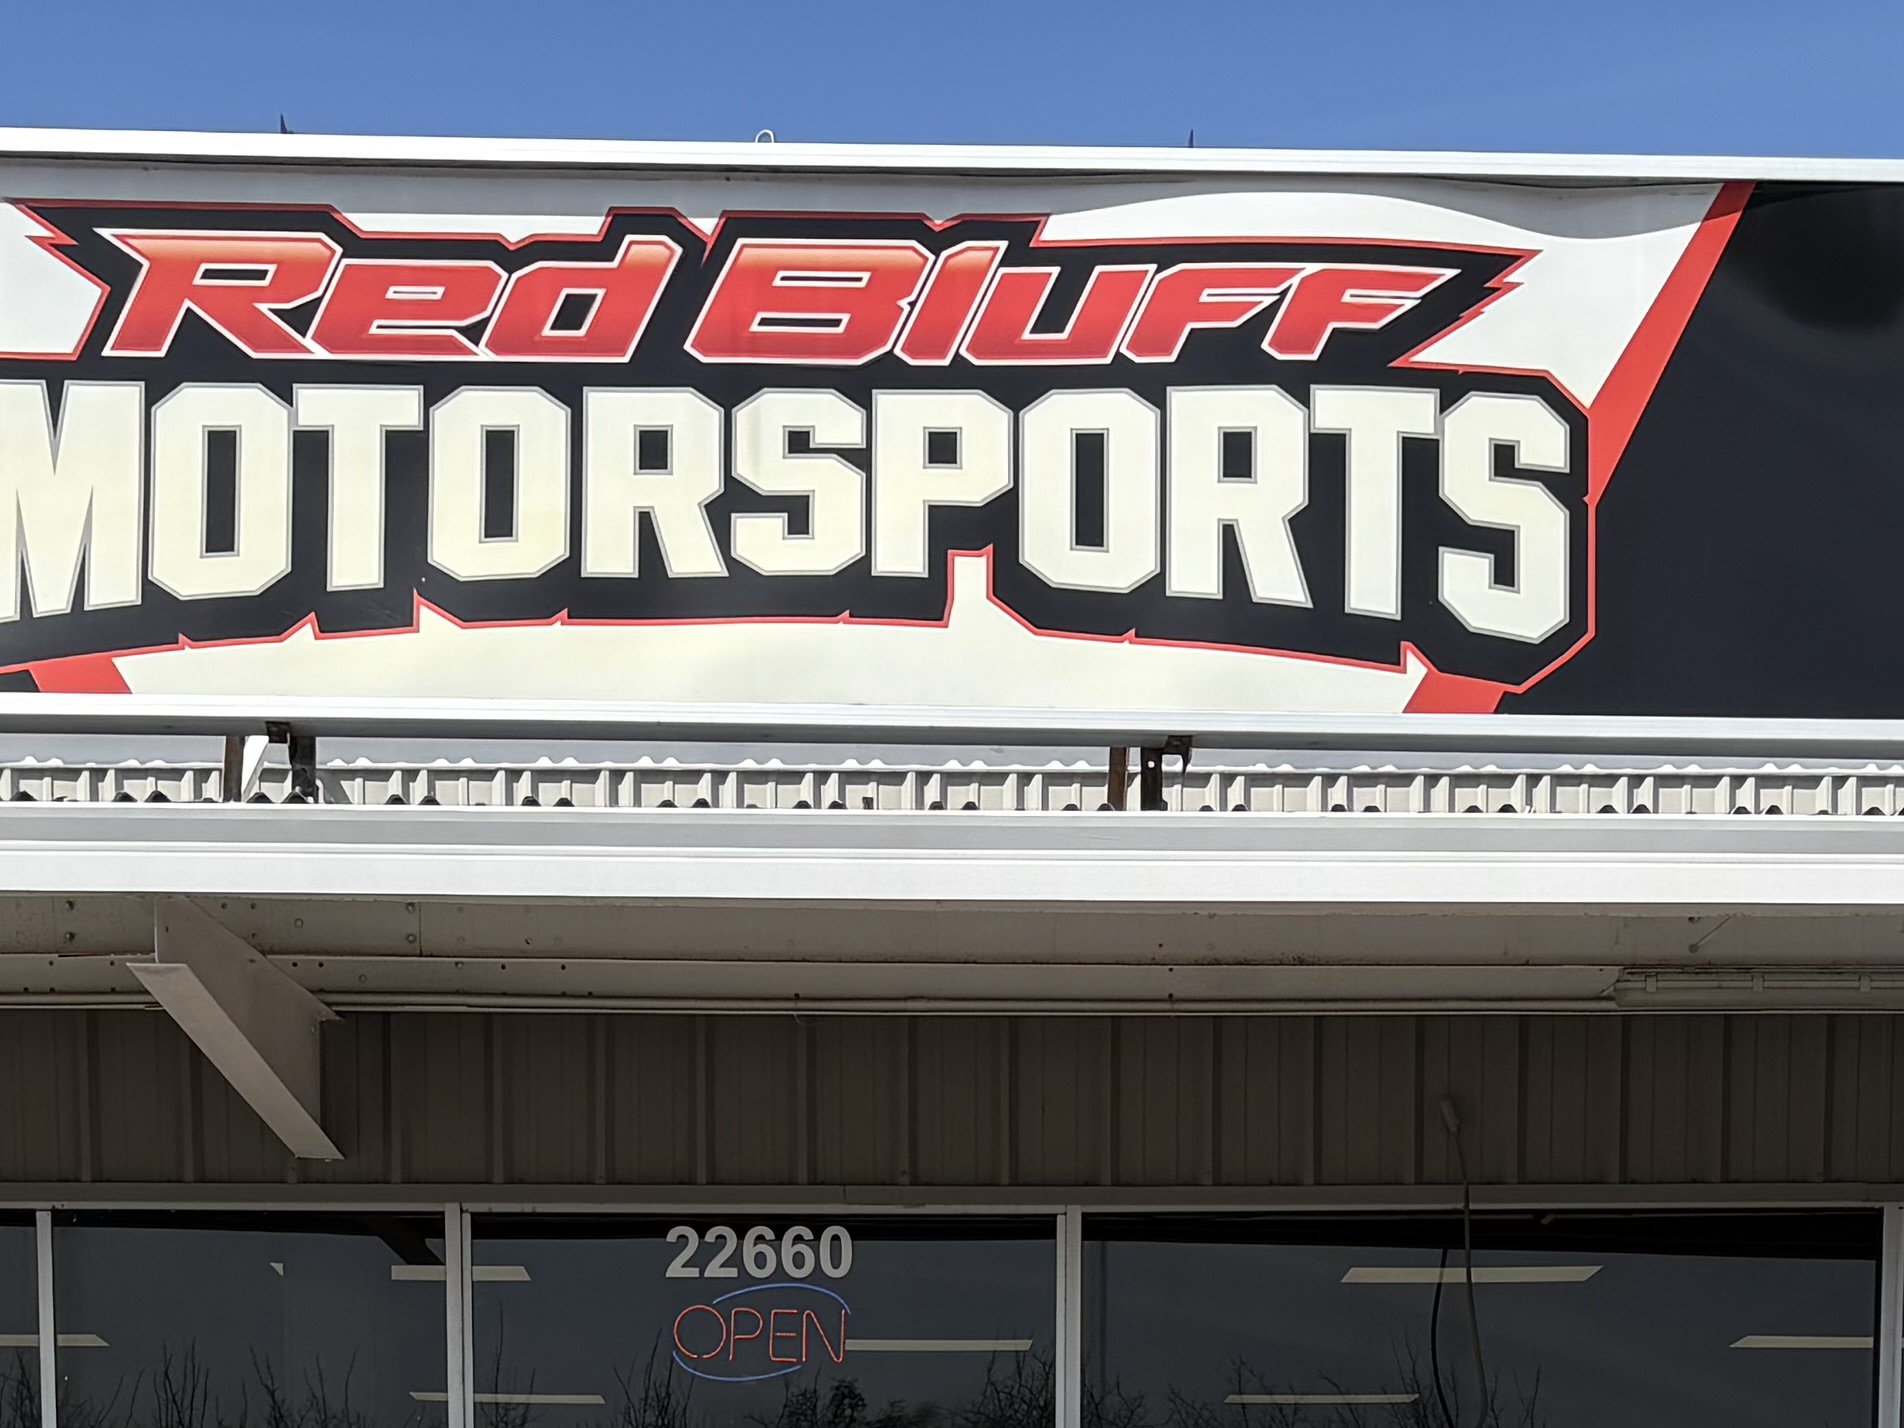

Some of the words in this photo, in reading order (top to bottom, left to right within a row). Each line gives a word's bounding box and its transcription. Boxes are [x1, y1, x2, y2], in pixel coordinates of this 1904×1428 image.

[94, 228, 681, 362] Red
[665, 1225, 853, 1279] 22660
[673, 1304, 847, 1364] OPEN
